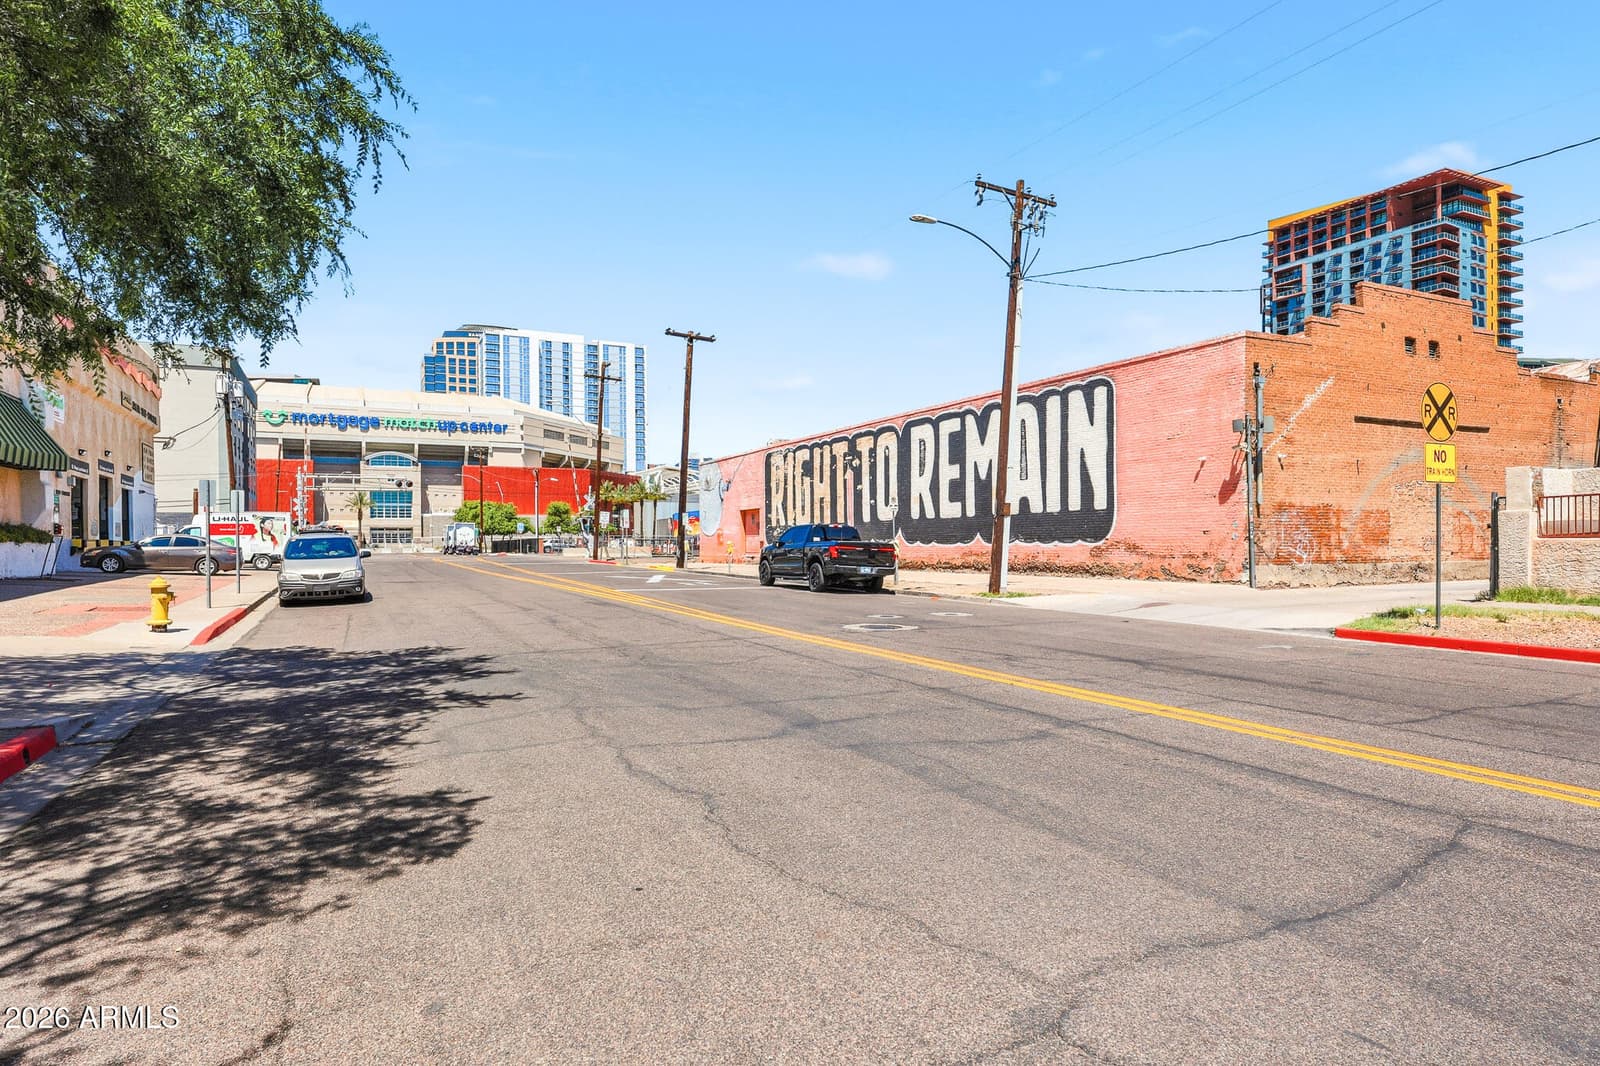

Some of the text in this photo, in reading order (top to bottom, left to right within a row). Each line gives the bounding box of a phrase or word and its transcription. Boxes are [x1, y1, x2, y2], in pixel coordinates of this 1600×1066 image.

[291, 412, 380, 432] mortgage
[460, 420, 508, 434] center
[769, 385, 1108, 526] RIGHT TO REMAIN
[1433, 449, 1447, 463] NO
